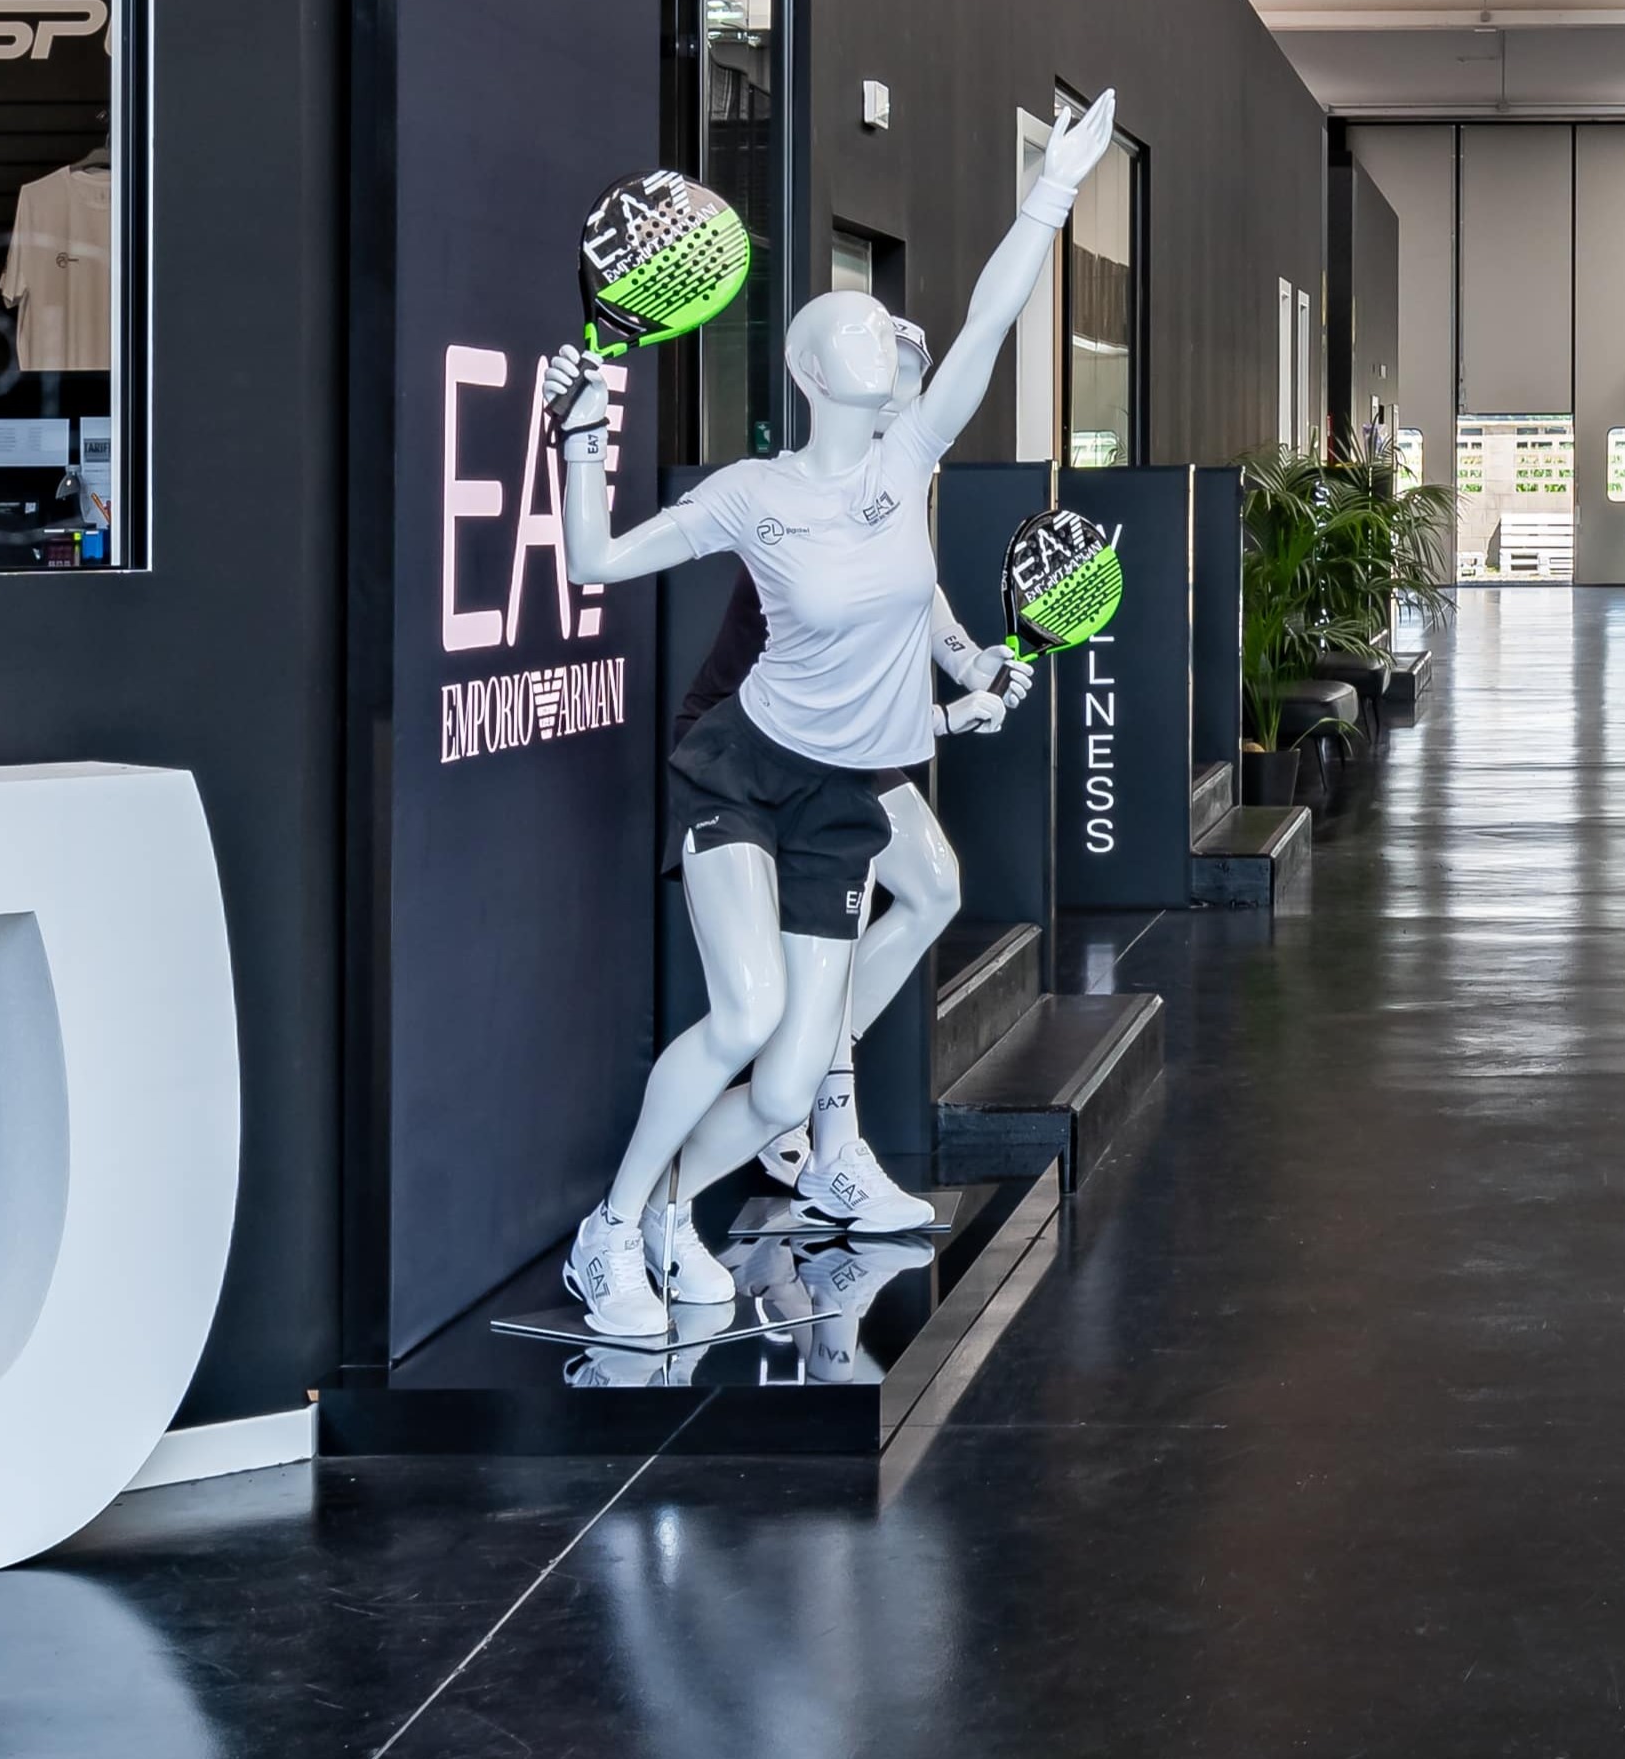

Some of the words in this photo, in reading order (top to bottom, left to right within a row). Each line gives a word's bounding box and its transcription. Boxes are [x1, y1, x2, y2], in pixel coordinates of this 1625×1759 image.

[583, 170, 691, 269] EA7
[587, 434, 599, 454] EA7
[863, 491, 894, 522] EA7
[1012, 511, 1085, 590] EA7
[1085, 524, 1122, 853] LNESS
[441, 671, 533, 763] EMPORIO
[557, 658, 624, 738] ARMANI
[818, 1095, 850, 1111] EA7
[831, 1172, 869, 1206] EA7
[589, 1256, 611, 1298] EA7
